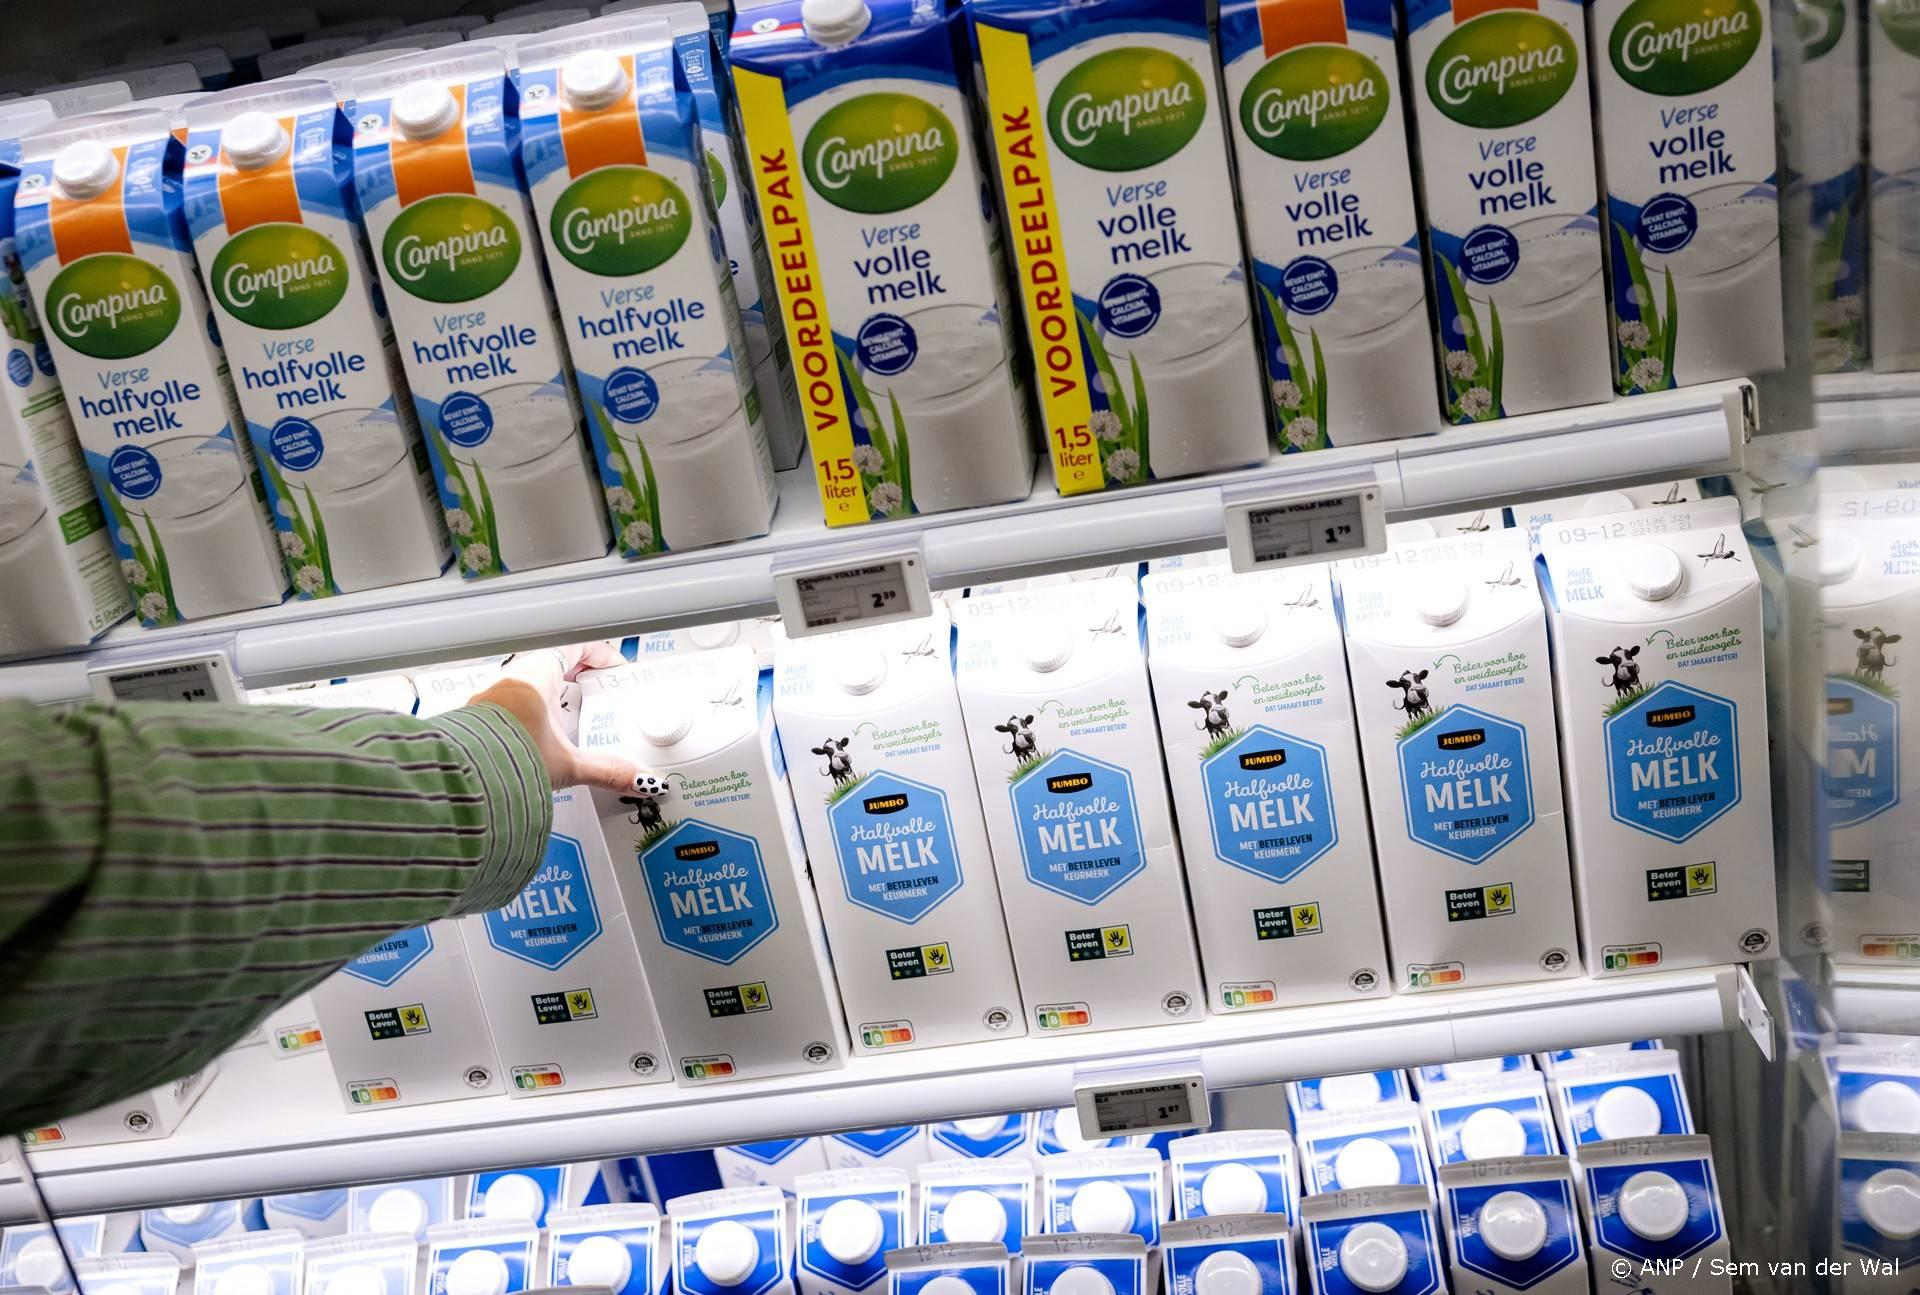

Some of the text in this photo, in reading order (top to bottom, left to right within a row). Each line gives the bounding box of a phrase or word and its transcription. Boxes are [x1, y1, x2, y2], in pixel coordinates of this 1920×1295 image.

[1622, 9, 1749, 72] Campina
[1438, 44, 1565, 105] Campina
[1060, 81, 1192, 147] Campina
[1253, 75, 1376, 138] Campina
[1660, 103, 1719, 129] Verse
[1479, 135, 1537, 162] Verse
[1649, 127, 1726, 159] volle
[816, 128, 944, 189] Campina
[1659, 149, 1736, 184] melk
[1294, 167, 1351, 193] Verse
[1469, 158, 1545, 190] volle
[1106, 180, 1167, 208] Verse
[1480, 183, 1556, 216] melk
[1285, 191, 1360, 222] volle
[563, 198, 678, 254] Campina
[1097, 204, 1176, 238] volle
[1297, 214, 1372, 248] melk
[862, 222, 921, 249] Verse
[1111, 228, 1191, 265] melk
[395, 226, 507, 281] Campina
[854, 246, 931, 278] volle
[1002, 106, 1077, 398] VOORDEELPAK
[224, 254, 335, 307] Campina
[761, 148, 839, 431] VOORDEELPAK
[868, 270, 946, 305] melk
[600, 283, 655, 309] Verse
[58, 284, 167, 337] Campina
[579, 298, 705, 339] halfvolle
[433, 311, 486, 335] Verse
[263, 337, 315, 360] Verse
[413, 324, 537, 364] halfvolle
[612, 328, 685, 359] melk
[98, 367, 150, 390] Verse
[243, 351, 365, 389] halfvolle
[447, 354, 517, 384] melk
[79, 380, 200, 418] halfvolle
[276, 380, 346, 410] melk
[113, 408, 182, 438] melk
[1054, 424, 1091, 452] 1,5
[1059, 450, 1094, 468] liter
[819, 458, 855, 485] 1,5
[824, 483, 858, 501] liter
[1559, 521, 1626, 545] 09-12
[1565, 585, 1604, 602] MELK
[645, 640, 675, 653] MELK
[1665, 627, 1741, 650] Beter voor koe
[1666, 637, 1743, 661] en weidevogels
[1452, 652, 1526, 674] Beter voor koe
[1454, 661, 1529, 684] en weidevogels
[1677, 659, 1691, 668] DAT
[1691, 656, 1716, 667] SMAAKT
[1651, 710, 1692, 724] JUMBO
[1442, 733, 1481, 746] JUMBO
[1626, 730, 1721, 758] Halfvolle
[1243, 754, 1282, 766] JUMBO
[1420, 753, 1512, 780] Halfvolle
[1631, 751, 1720, 792] MELK
[1052, 777, 1089, 789] JUMBO
[1224, 773, 1313, 800] Halfvolle
[1425, 773, 1512, 813] MELK
[868, 798, 904, 810] JUMBO
[1033, 797, 1120, 823] Halfvolle
[1229, 793, 1315, 832] MELK
[1638, 792, 1715, 810] MET BETER LEVEN
[1653, 805, 1702, 820] KEURMERK
[851, 817, 936, 843] Halfvolle
[1434, 814, 1509, 832] MET BETER LEVEN
[1449, 826, 1497, 840] KEURMERK
[1038, 817, 1122, 855] MELK
[1239, 833, 1313, 851] MET BETER LEVEN
[680, 845, 716, 857] JUMBO
[856, 837, 940, 875] MELK
[1254, 846, 1301, 860] KEURMERK
[663, 863, 748, 889] Halfvolle
[1049, 857, 1121, 873] MET BETER LEVEN
[1063, 869, 1109, 882] KEURMERK
[1650, 871, 1679, 880] Beter
[868, 876, 939, 893] MET BETER LEVEN
[883, 887, 928, 901] KEURMERK
[1450, 891, 1477, 900] Beter
[1651, 878, 1681, 889] Leven
[501, 885, 577, 921] MELK
[669, 881, 753, 919] MELK
[1451, 899, 1480, 909] Leven
[1257, 910, 1284, 919] Beter
[1259, 918, 1287, 928] Leven
[510, 923, 577, 940] MET BETER LEVEN
[683, 919, 753, 936] MET BETER LEVEN
[698, 930, 743, 944] KEURMERK
[1069, 932, 1095, 941] Beter
[384, 940, 409, 952] LEVEN
[524, 934, 568, 947] KEURMERK
[1071, 940, 1099, 950] Leven
[890, 951, 916, 960] Beter
[892, 958, 919, 968] Leven
[535, 996, 560, 1005] Beter
[708, 989, 733, 999] Beter
[710, 998, 737, 1006] Leven
[368, 1012, 393, 1021] Beter
[537, 1004, 564, 1013] Leven
[371, 1019, 397, 1029] Leven
[1471, 1160, 1512, 1176] 10-12
[1334, 1193, 1371, 1208] 10-12
[1196, 1221, 1234, 1238] 12-12
[1053, 1236, 1095, 1251] 12-12
